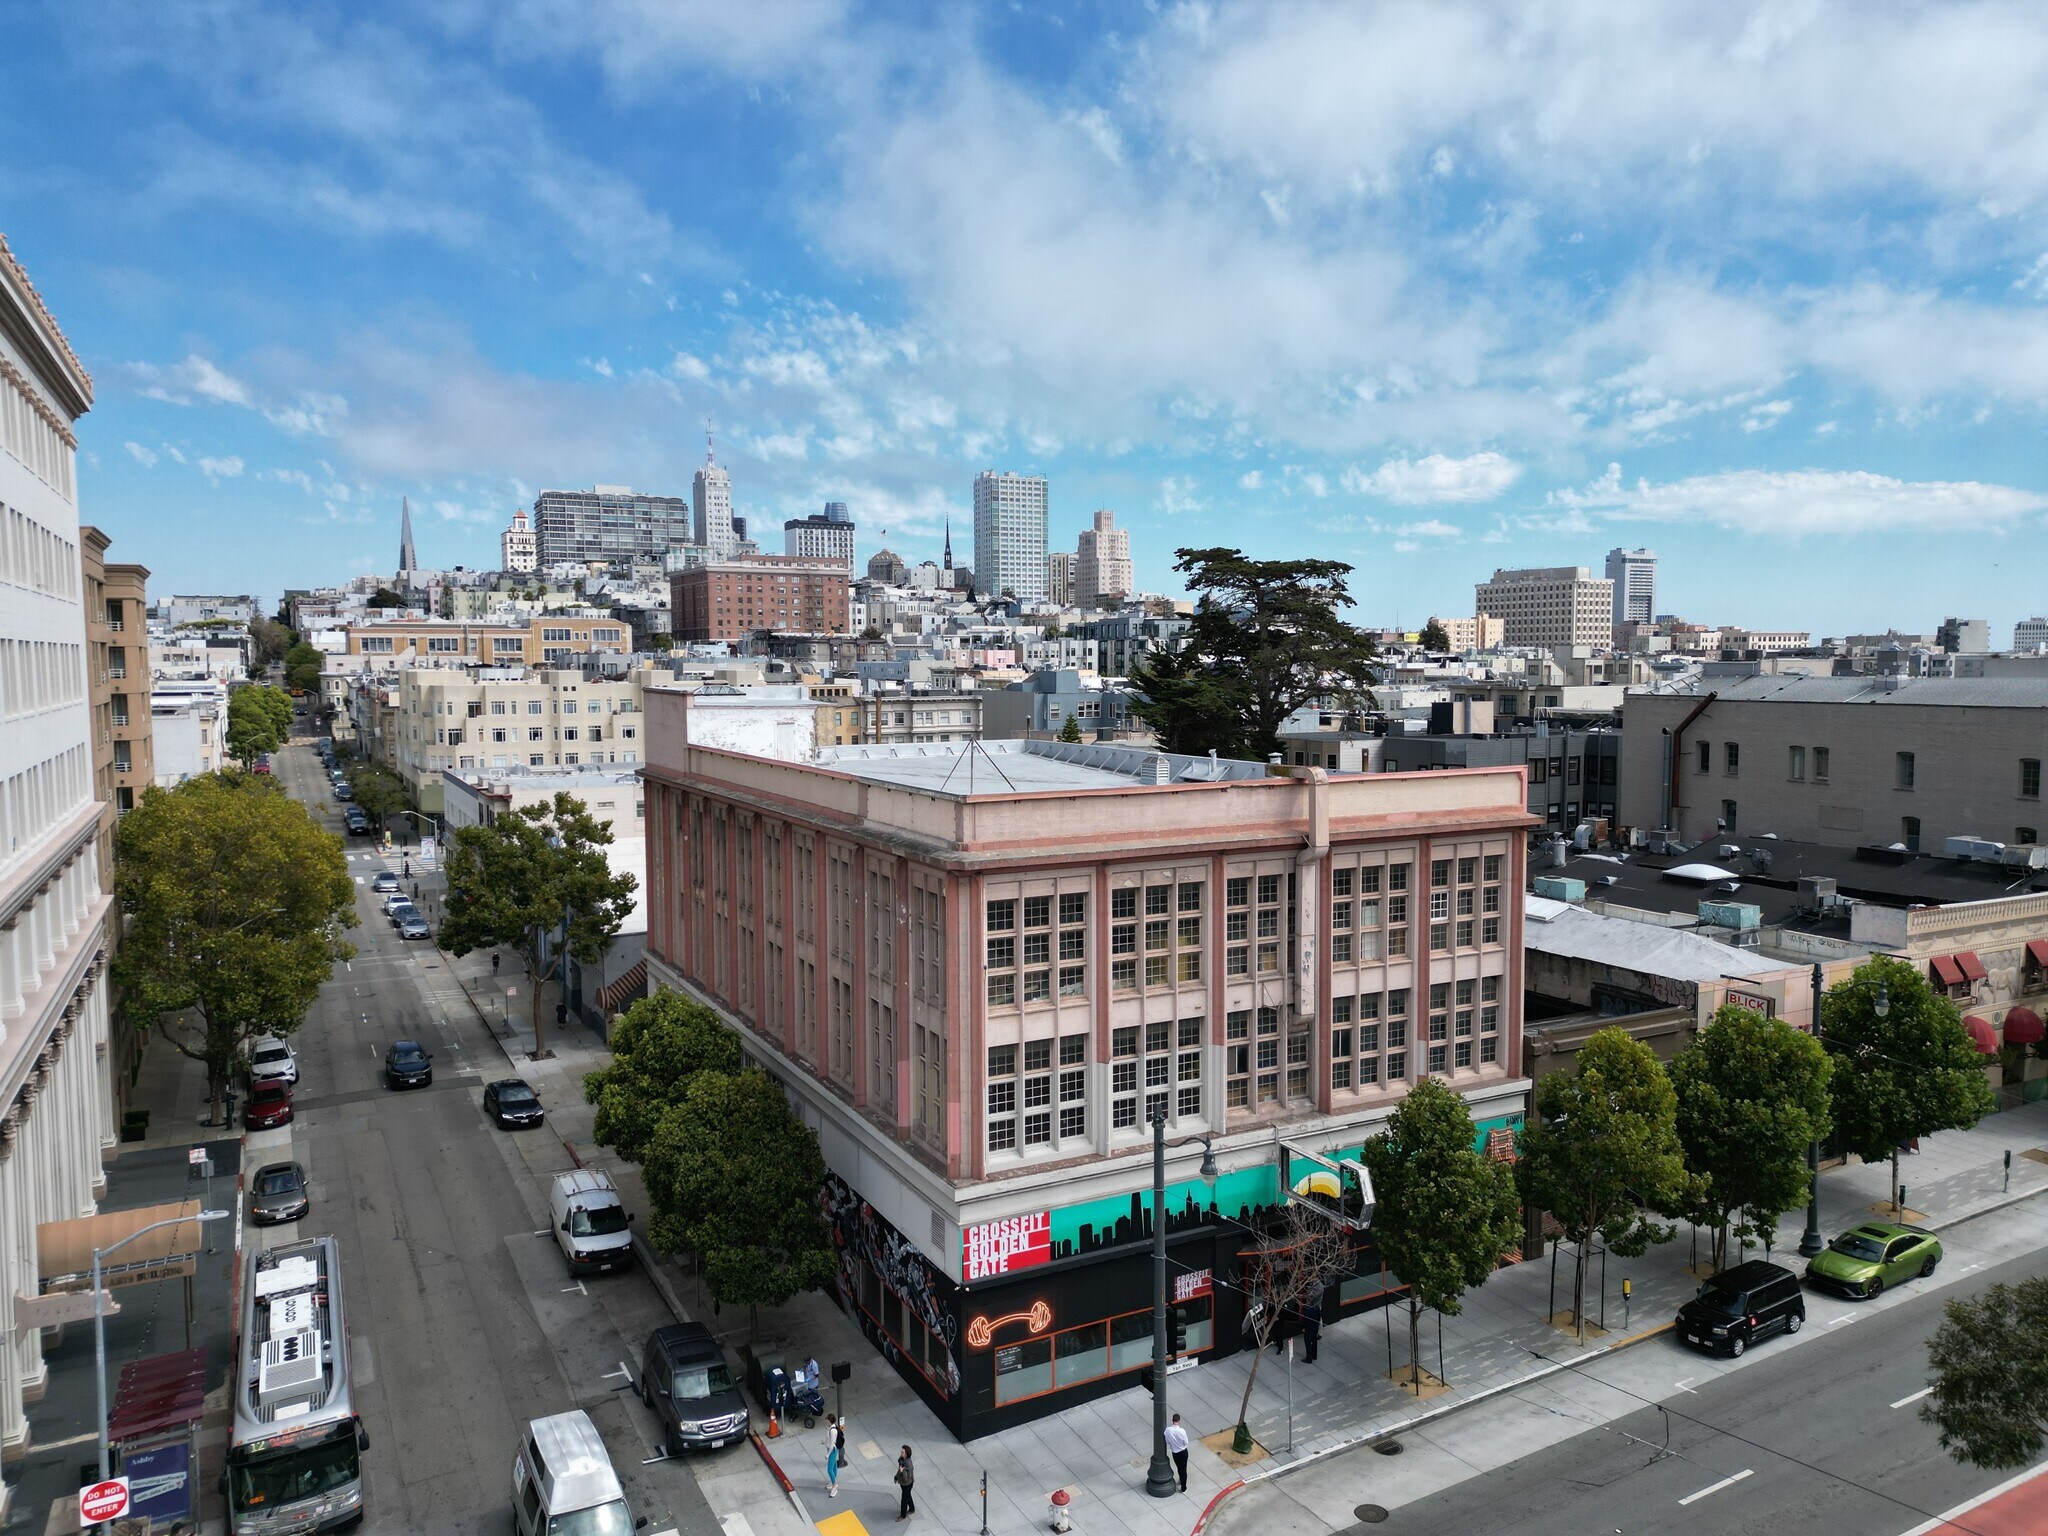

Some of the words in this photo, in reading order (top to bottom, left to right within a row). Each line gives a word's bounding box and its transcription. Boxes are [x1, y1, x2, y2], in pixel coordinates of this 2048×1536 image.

[1729, 993, 1765, 1011] BLICK
[969, 1212, 1045, 1245] CROSSFIT
[969, 1232, 1029, 1261] GOLDEN
[969, 1256, 1009, 1279] GATE
[1177, 1269, 1209, 1285] CROSSFIT
[250, 1441, 265, 1453] 12
[131, 1456, 155, 1466] Ashby
[88, 1492, 100, 1501] DO
[104, 1485, 121, 1496] NOT
[91, 1503, 118, 1517] ENTER
